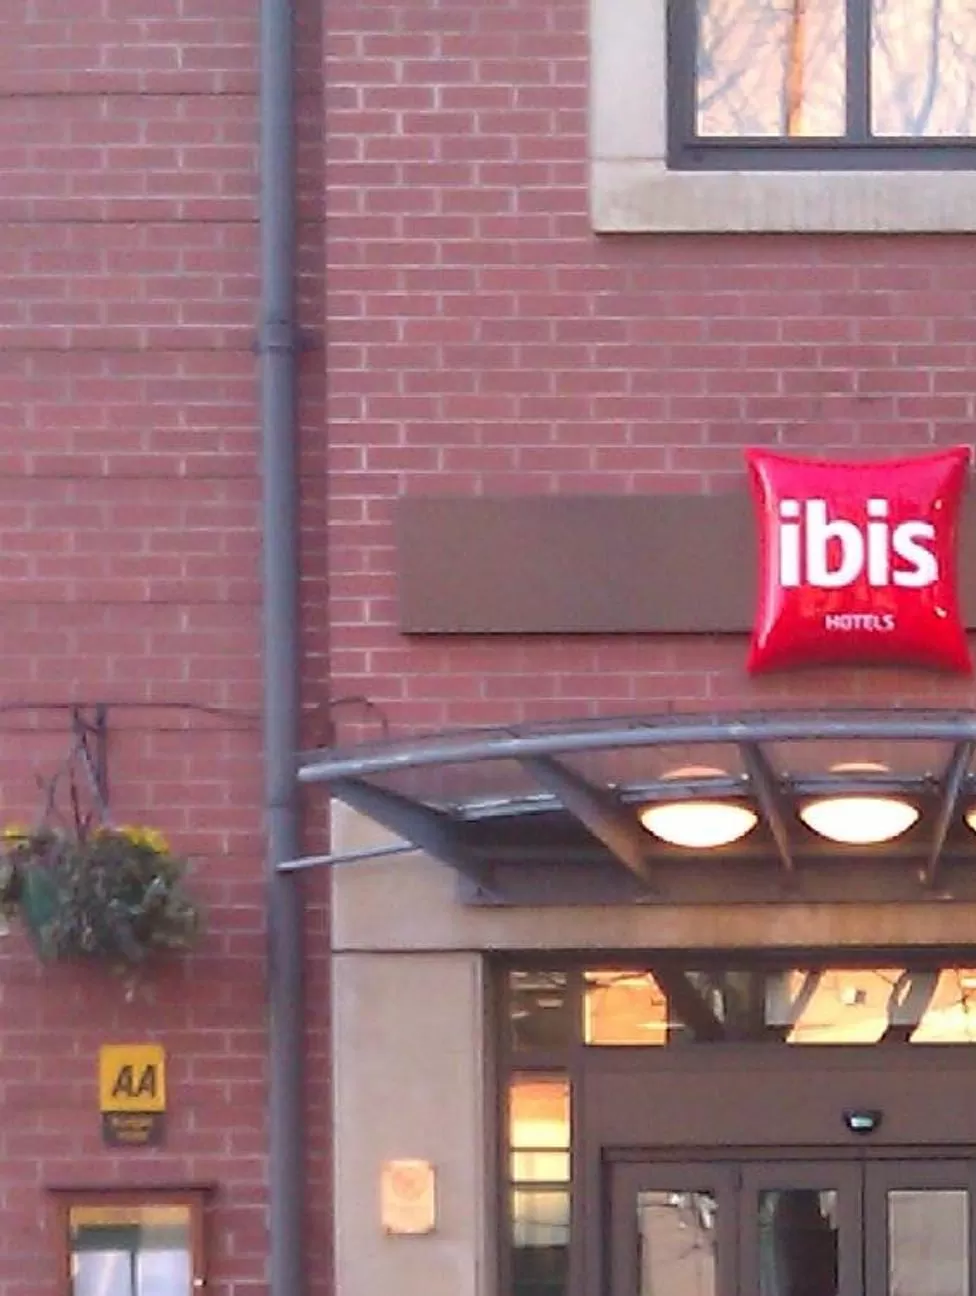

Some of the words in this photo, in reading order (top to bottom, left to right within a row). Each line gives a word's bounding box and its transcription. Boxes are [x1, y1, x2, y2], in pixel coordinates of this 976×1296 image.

[779, 498, 939, 587] ibis
[825, 614, 895, 632] HOTELS
[112, 1064, 157, 1098] AA
